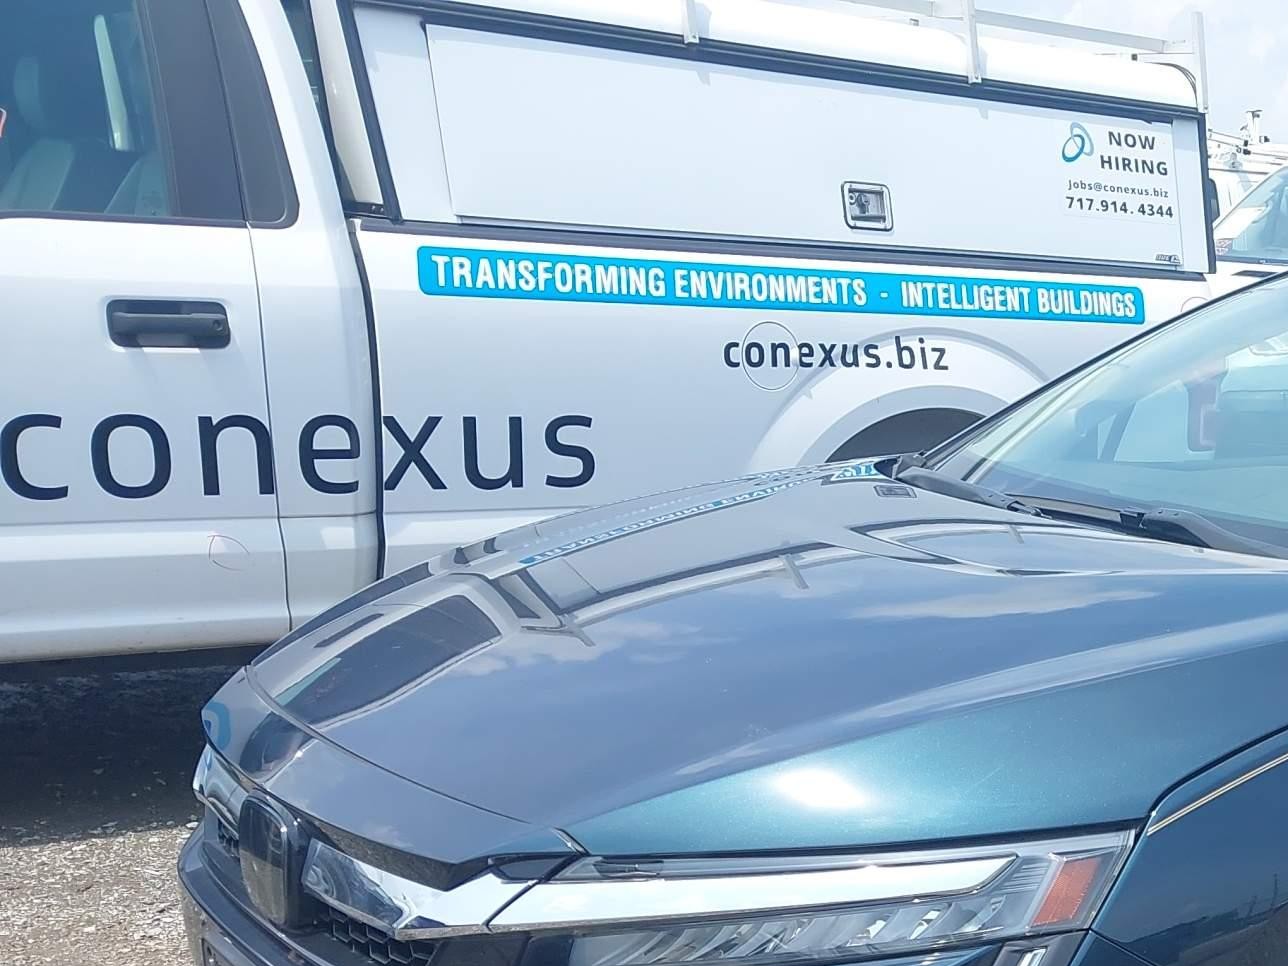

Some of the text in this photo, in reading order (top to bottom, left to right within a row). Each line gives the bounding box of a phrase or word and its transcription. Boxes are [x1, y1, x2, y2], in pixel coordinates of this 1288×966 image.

[1108, 131, 1155, 150] NOW
[1100, 154, 1168, 176] HIRING
[1065, 196, 1174, 218] 717.914.4344
[431, 254, 666, 297] TRANSFORMING
[675, 269, 867, 306] ENVIRONMENTS
[902, 280, 1030, 313] INTELLIGENT
[1038, 286, 1136, 318] BUILDINGS
[723, 335, 949, 371] conexus.biz
[0, 412, 595, 501] conexus
